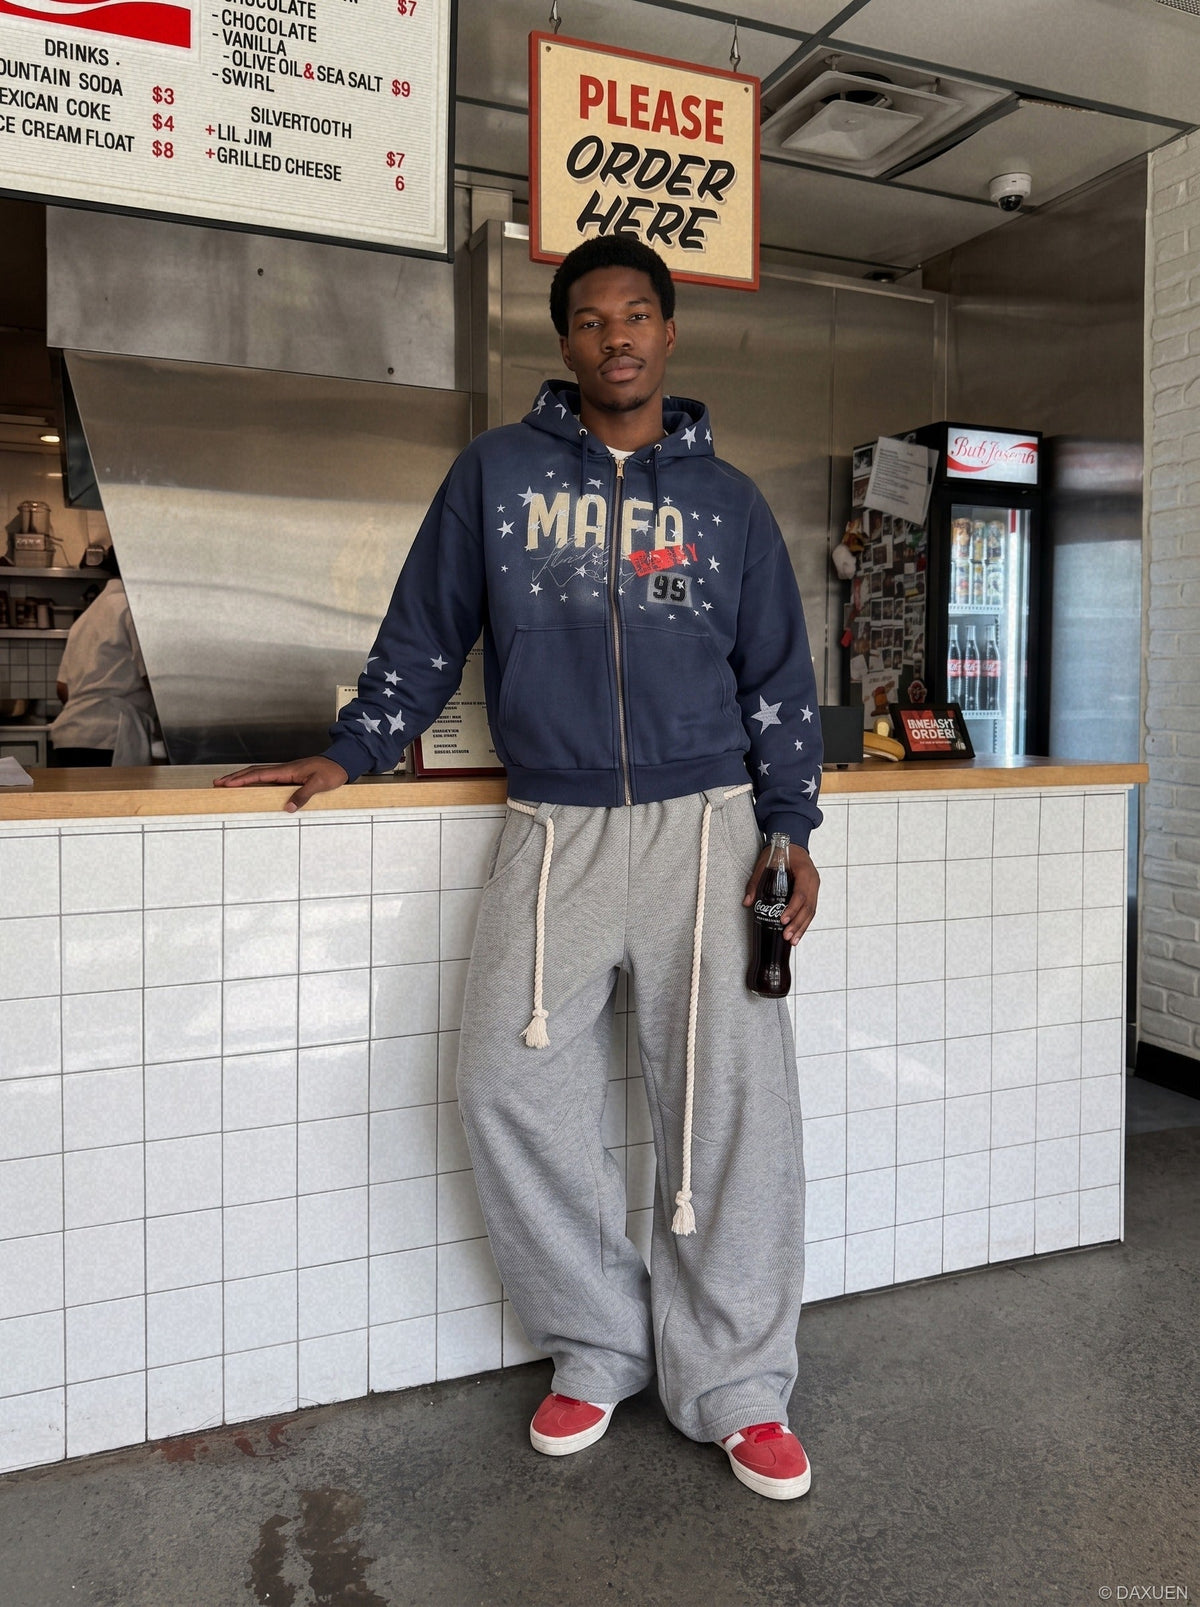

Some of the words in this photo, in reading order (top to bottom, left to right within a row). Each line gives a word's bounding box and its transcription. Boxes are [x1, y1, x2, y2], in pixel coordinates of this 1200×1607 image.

[45, 38, 109, 66] DRINKS
[79, 73, 123, 96] SODA
[152, 85, 175, 105] $3
[317, 66, 345, 85] SEA
[348, 72, 383, 92] SALT
[391, 79, 411, 97] $9
[66, 98, 111, 122] COKE
[152, 113, 175, 132] $4
[251, 106, 352, 139] SILVERTOOTH
[580, 74, 723, 144] PLEASE
[22, 119, 81, 144] CREAM
[86, 129, 135, 152] FLOAT
[152, 140, 174, 158] $8
[244, 130, 272, 148] JIM
[386, 151, 405, 168] $7
[285, 158, 342, 182] CHEESE
[395, 175, 405, 191] 6
[566, 135, 736, 202] ORDER
[576, 189, 719, 250] HERE
